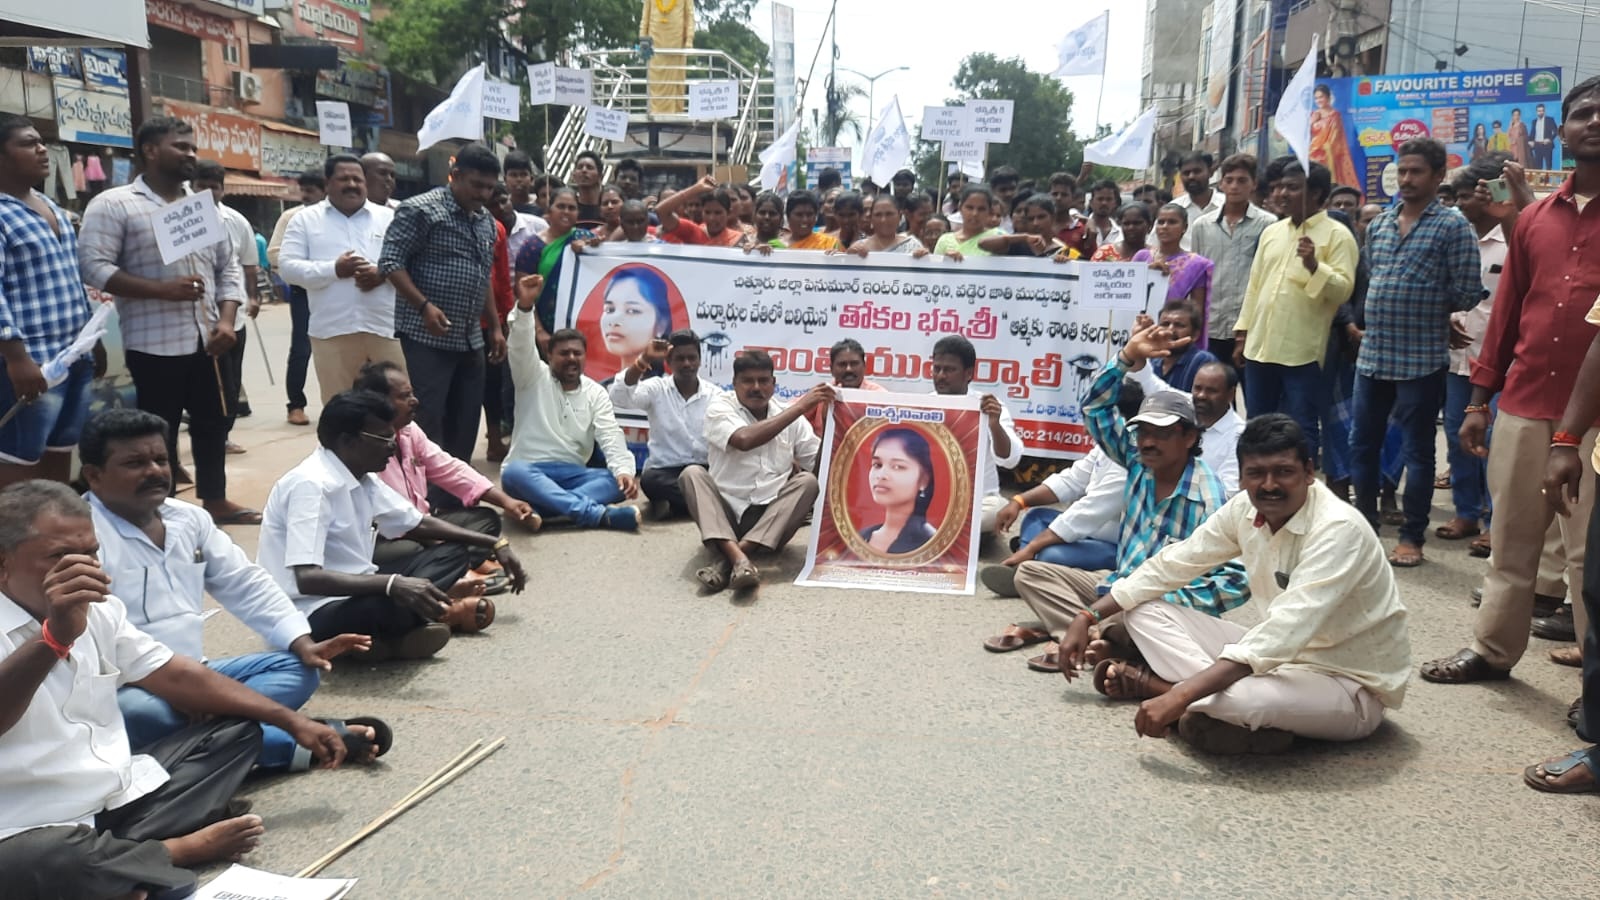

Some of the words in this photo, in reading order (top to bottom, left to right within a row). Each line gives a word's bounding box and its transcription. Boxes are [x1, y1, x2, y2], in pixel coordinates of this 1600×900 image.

[1375, 76, 1458, 93] FAVOURITE
[1462, 73, 1524, 89] SHOPEE
[484, 95, 507, 105] WANT
[485, 104, 512, 115] STICE
[936, 119, 959, 127] WANT
[930, 128, 962, 137] JUSTICE
[953, 141, 975, 149] WANT
[949, 150, 979, 158] JUSTICE
[734, 276, 774, 295] చిత్తూరు
[777, 277, 801, 295] జిల్లా
[863, 279, 900, 295] ఇంటర్
[956, 284, 987, 304] వడ్డెర
[989, 286, 1013, 300] జాతి
[750, 300, 782, 323] చేతిలో
[1046, 321, 1079, 341] శాంతి
